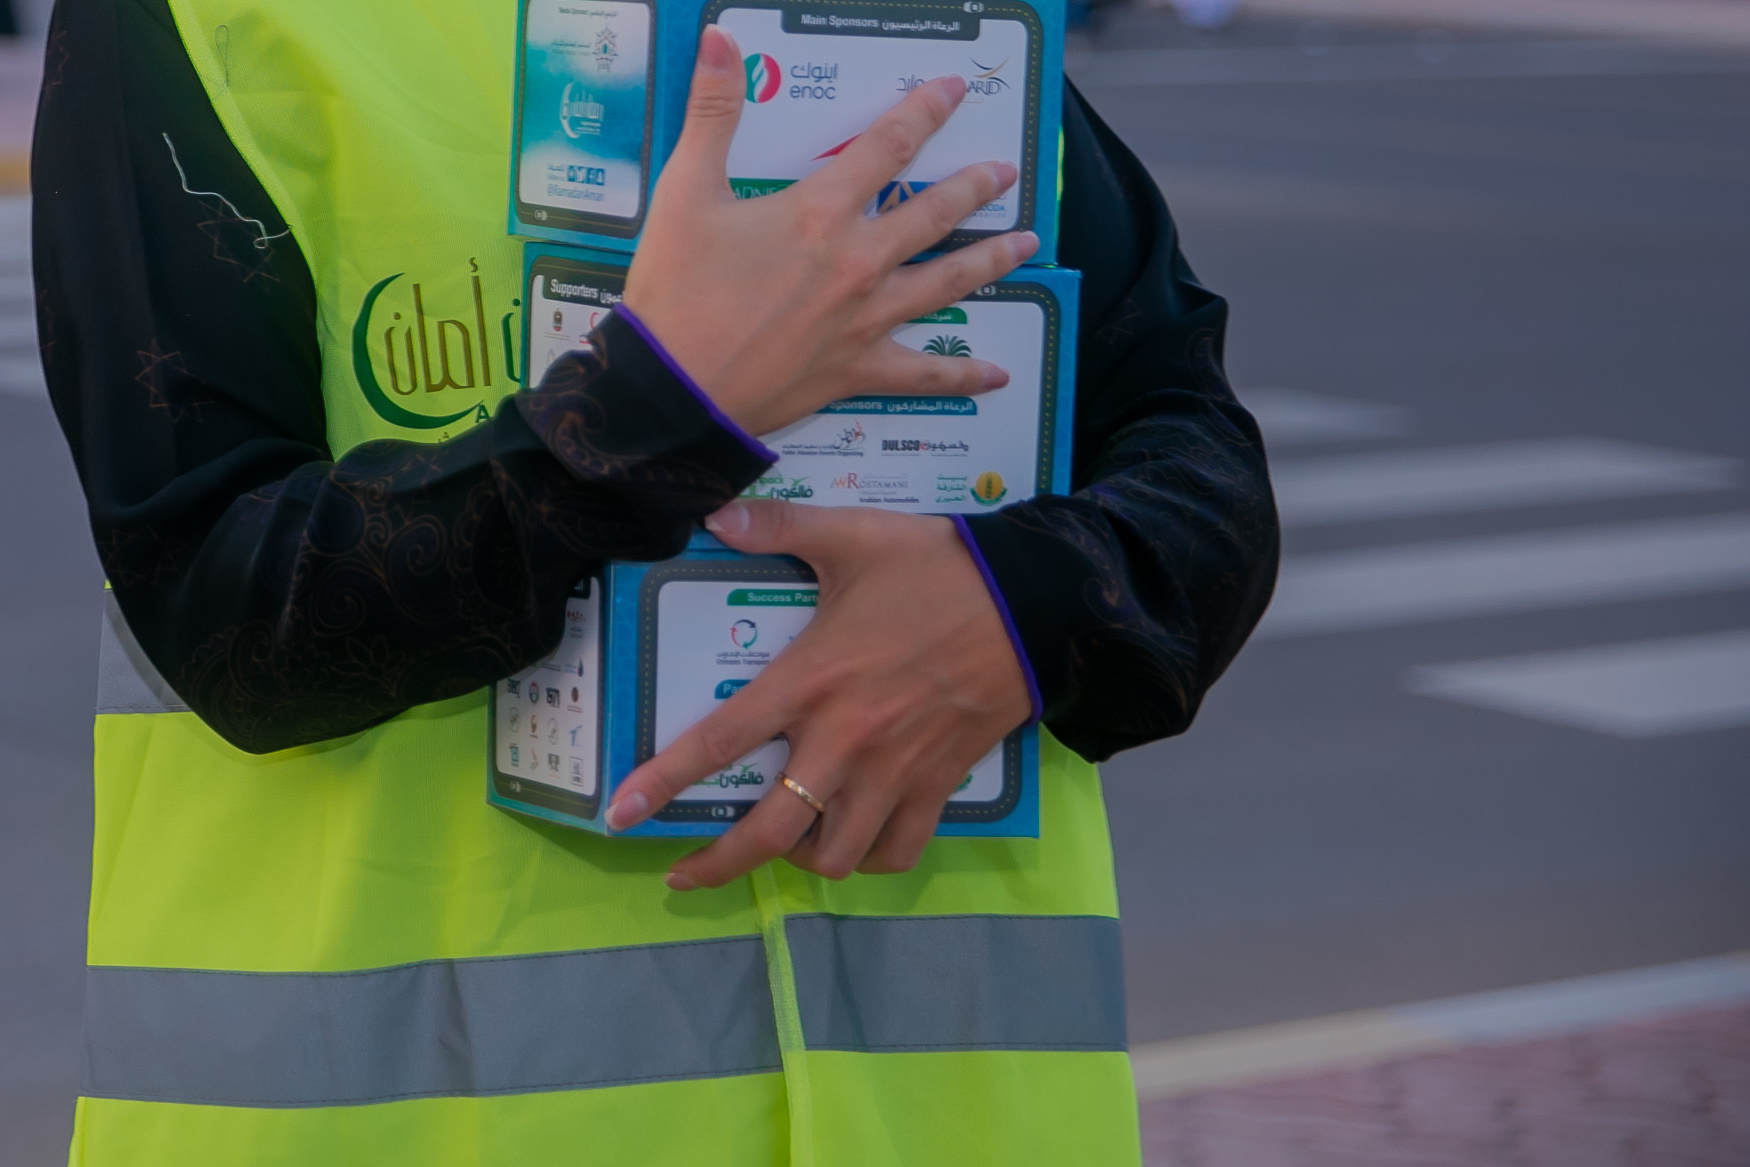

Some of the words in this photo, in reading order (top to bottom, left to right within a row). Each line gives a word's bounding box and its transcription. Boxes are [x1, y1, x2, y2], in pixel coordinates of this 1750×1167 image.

[800, 14, 827, 25] Main
[828, 15, 879, 29] Sponsors
[882, 18, 931, 31] الرئيسيون
[932, 20, 960, 32] الرعاة
[789, 85, 837, 100] enoc
[966, 80, 1001, 96] ARID
[550, 278, 599, 299] Supporters
[887, 400, 943, 413] المشاركون
[943, 401, 973, 412] الرعاة
[882, 439, 920, 451] DULSCO
[747, 592, 791, 602] Success
[794, 592, 819, 602] Part
